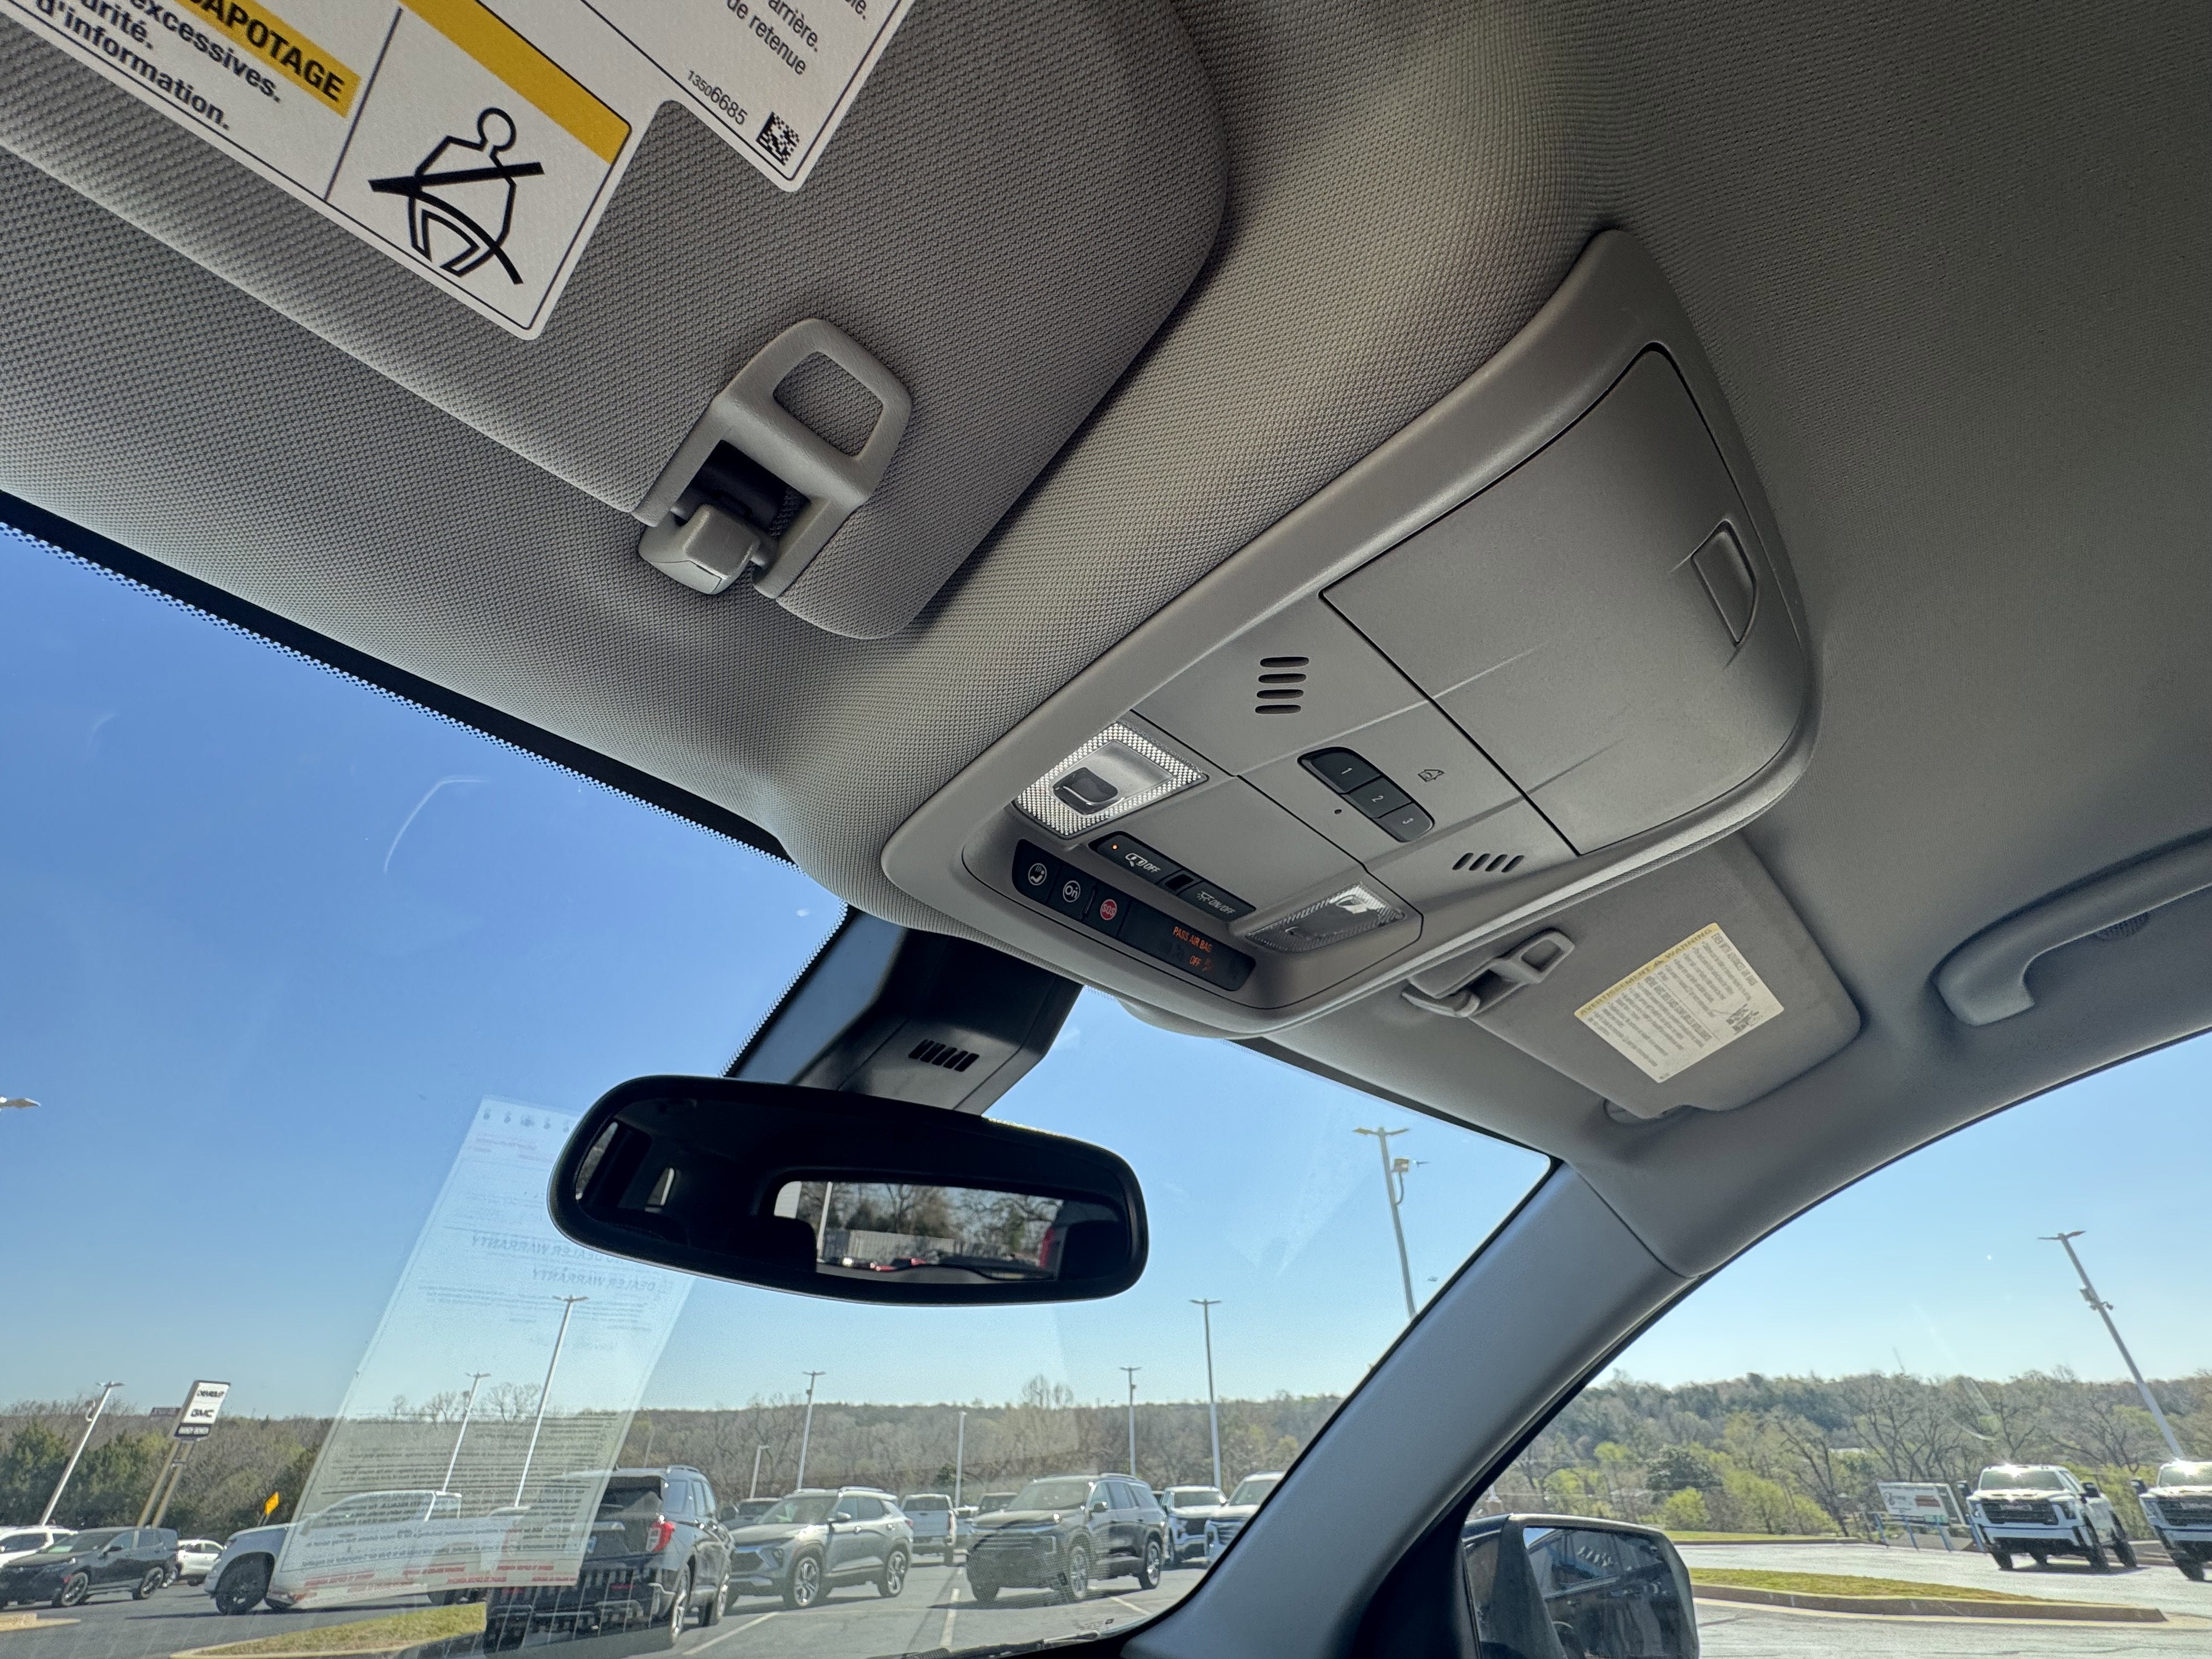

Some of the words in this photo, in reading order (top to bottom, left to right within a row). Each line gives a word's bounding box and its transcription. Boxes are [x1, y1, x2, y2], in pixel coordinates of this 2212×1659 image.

[748, 14, 806, 76] retenue
[769, 0, 818, 52] arrière.
[36, 0, 230, 131] d'information.
[129, 0, 281, 104] excessives.
[190, 0, 345, 103] APOTAGE
[687, 70, 748, 125] 13506685
[1143, 863, 1161, 873] OFF
[1102, 904, 1116, 916] SOS
[1209, 900, 1235, 913] ON/OFF
[1173, 926, 1189, 941] PASS
[1189, 935, 1200, 947] AIR
[1200, 940, 1212, 953] BAG
[1665, 929, 1713, 959] WARNING
[1189, 956, 1201, 966] OFF
